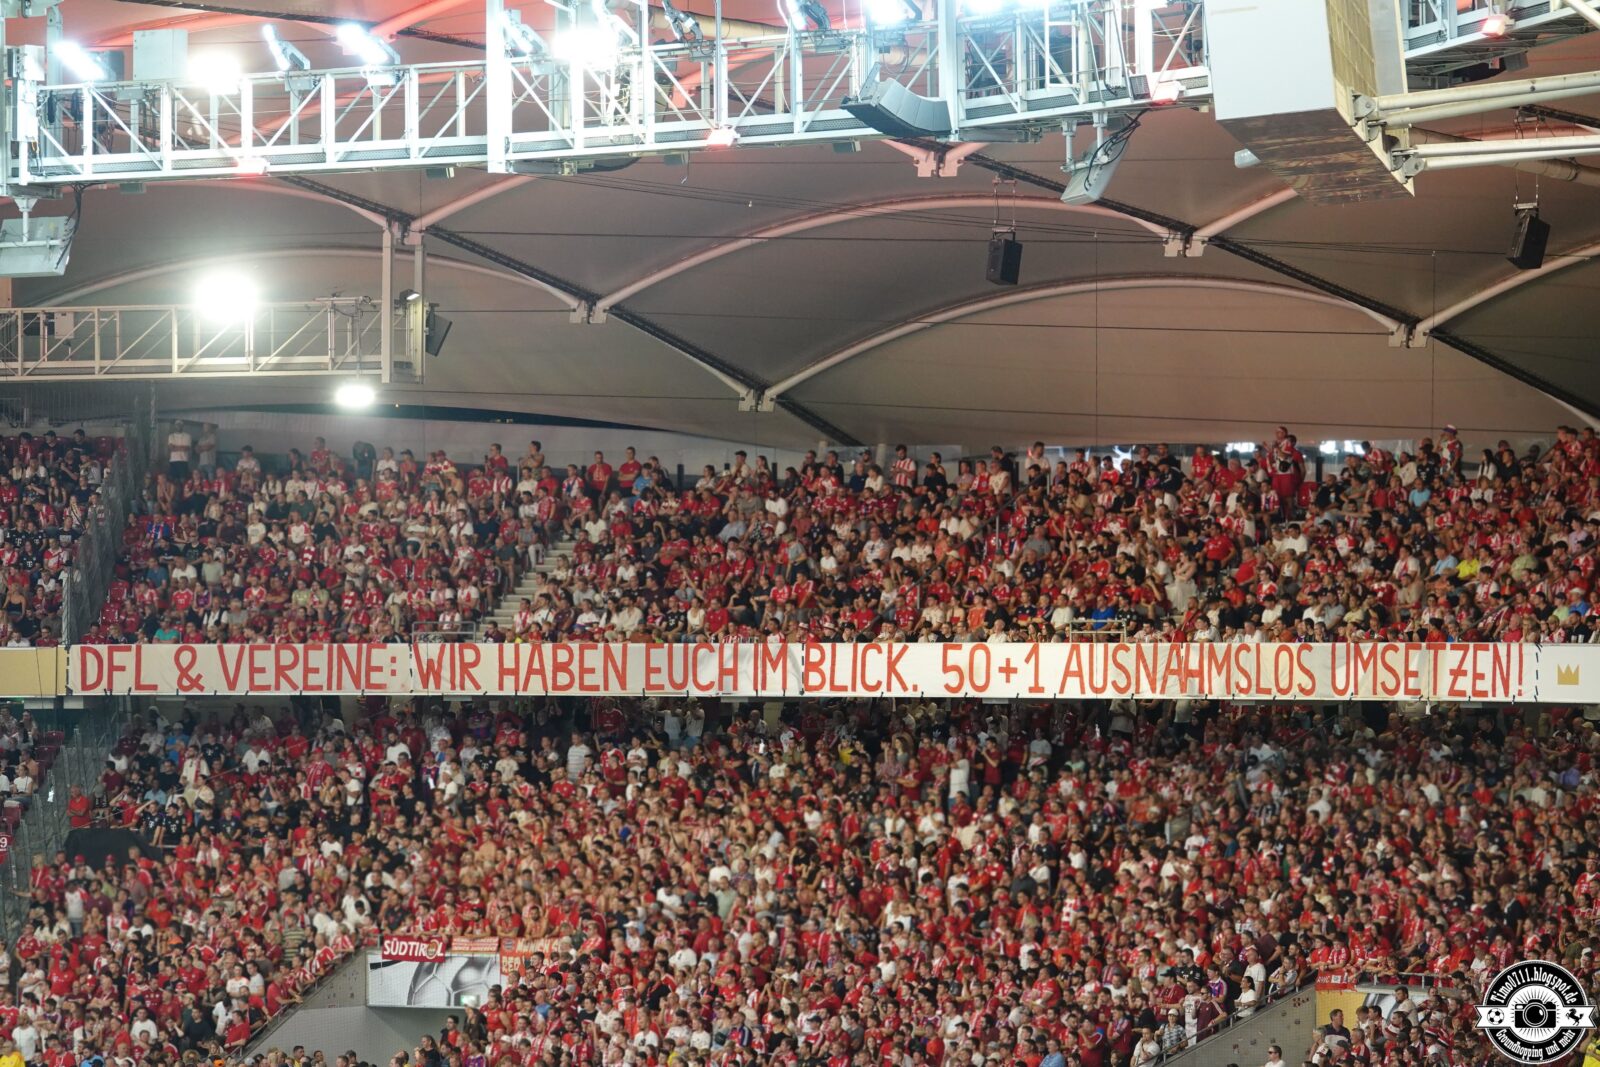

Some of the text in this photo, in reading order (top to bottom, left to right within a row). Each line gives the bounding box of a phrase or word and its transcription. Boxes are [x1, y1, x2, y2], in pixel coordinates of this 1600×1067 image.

[80, 643, 1524, 698] DFL & VEREINE: WIR HABEN EUCH IM BLICK. 50+1 AUSNAHMSLOS UMSETZEN!
[383, 937, 444, 960] SÜDTIROL
